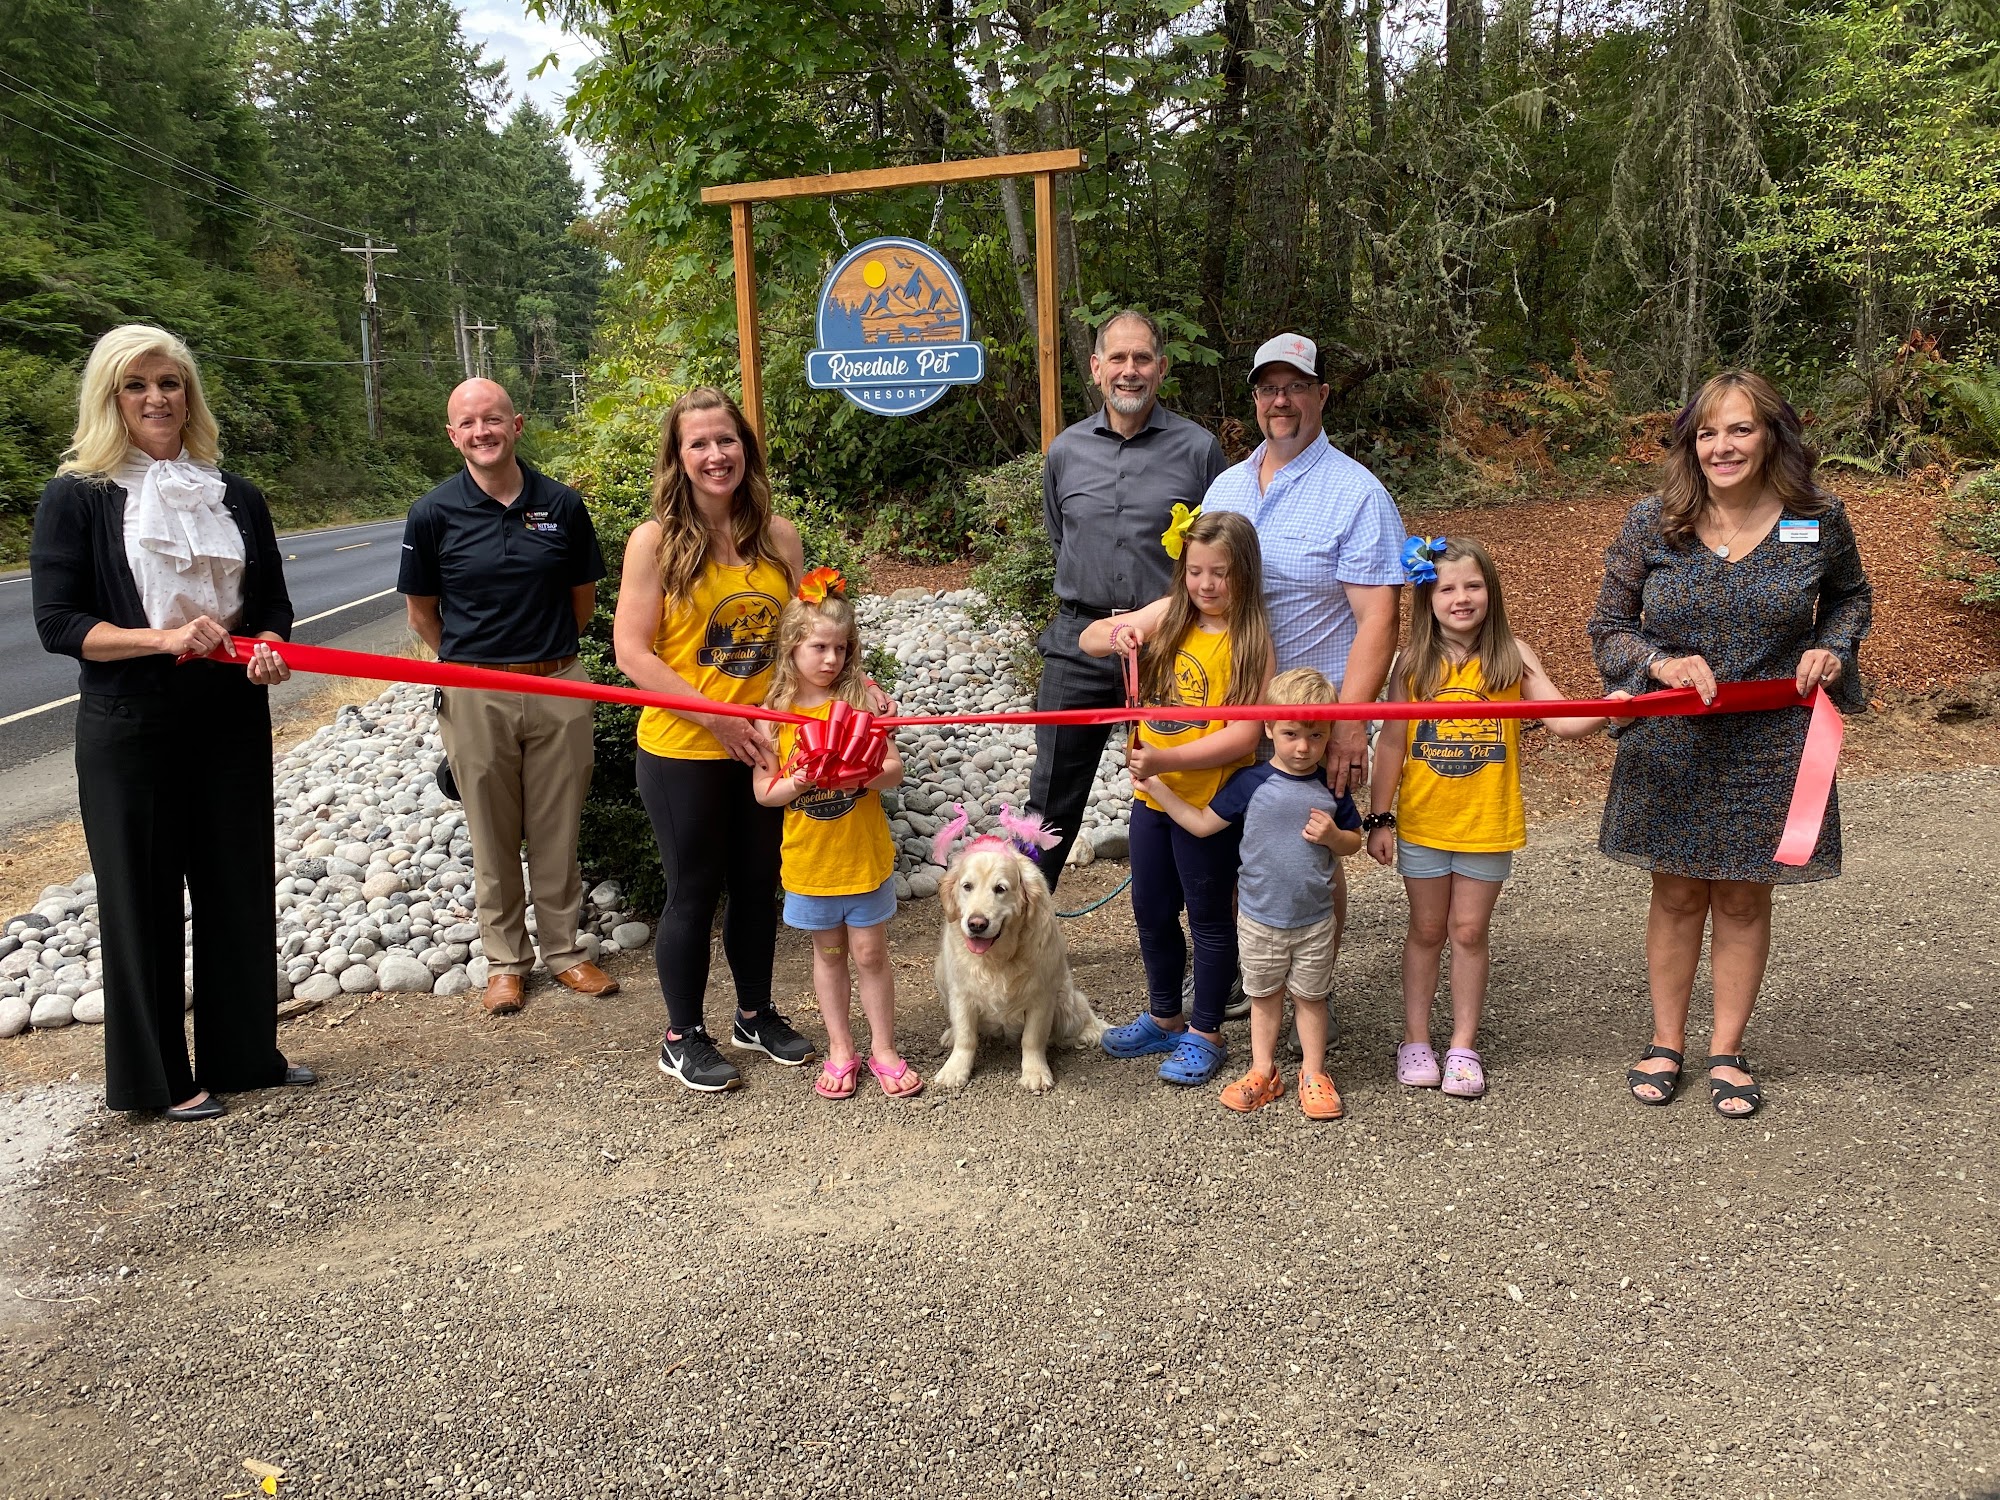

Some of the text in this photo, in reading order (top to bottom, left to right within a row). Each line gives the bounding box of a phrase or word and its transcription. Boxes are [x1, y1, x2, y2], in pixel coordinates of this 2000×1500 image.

[828, 349, 960, 383] Rosedale Pet
[863, 389, 927, 400] RESORT
[711, 648, 757, 663] Rosedale
[1420, 743, 1496, 760] Rosedale Pet
[811, 803, 848, 815] RESORT
